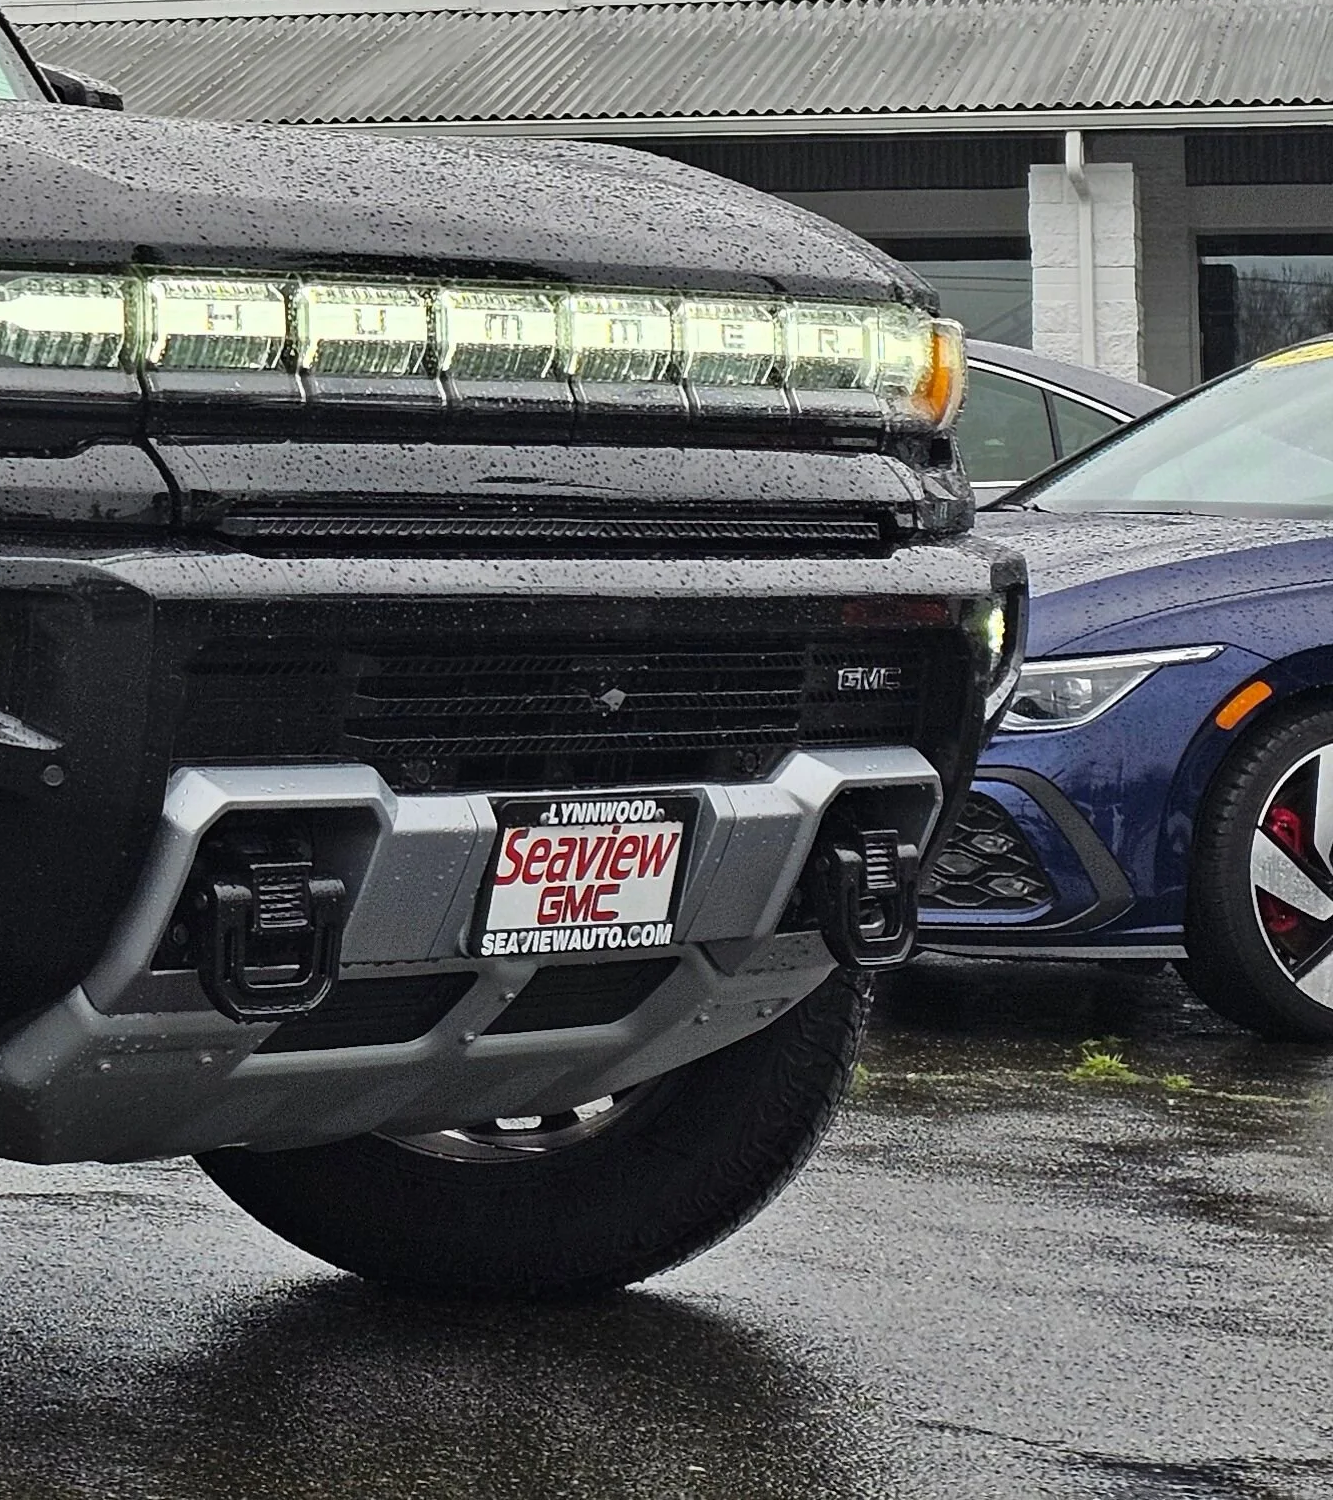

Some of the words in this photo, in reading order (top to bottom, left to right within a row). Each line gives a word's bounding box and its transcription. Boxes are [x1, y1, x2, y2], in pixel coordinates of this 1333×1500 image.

[838, 667, 902, 691] GMC
[548, 800, 657, 825] LYNNWOOD
[495, 826, 680, 885] Seaview
[537, 884, 620, 925] GMC
[482, 923, 673, 956] SEAVIEWAUTO.COM
